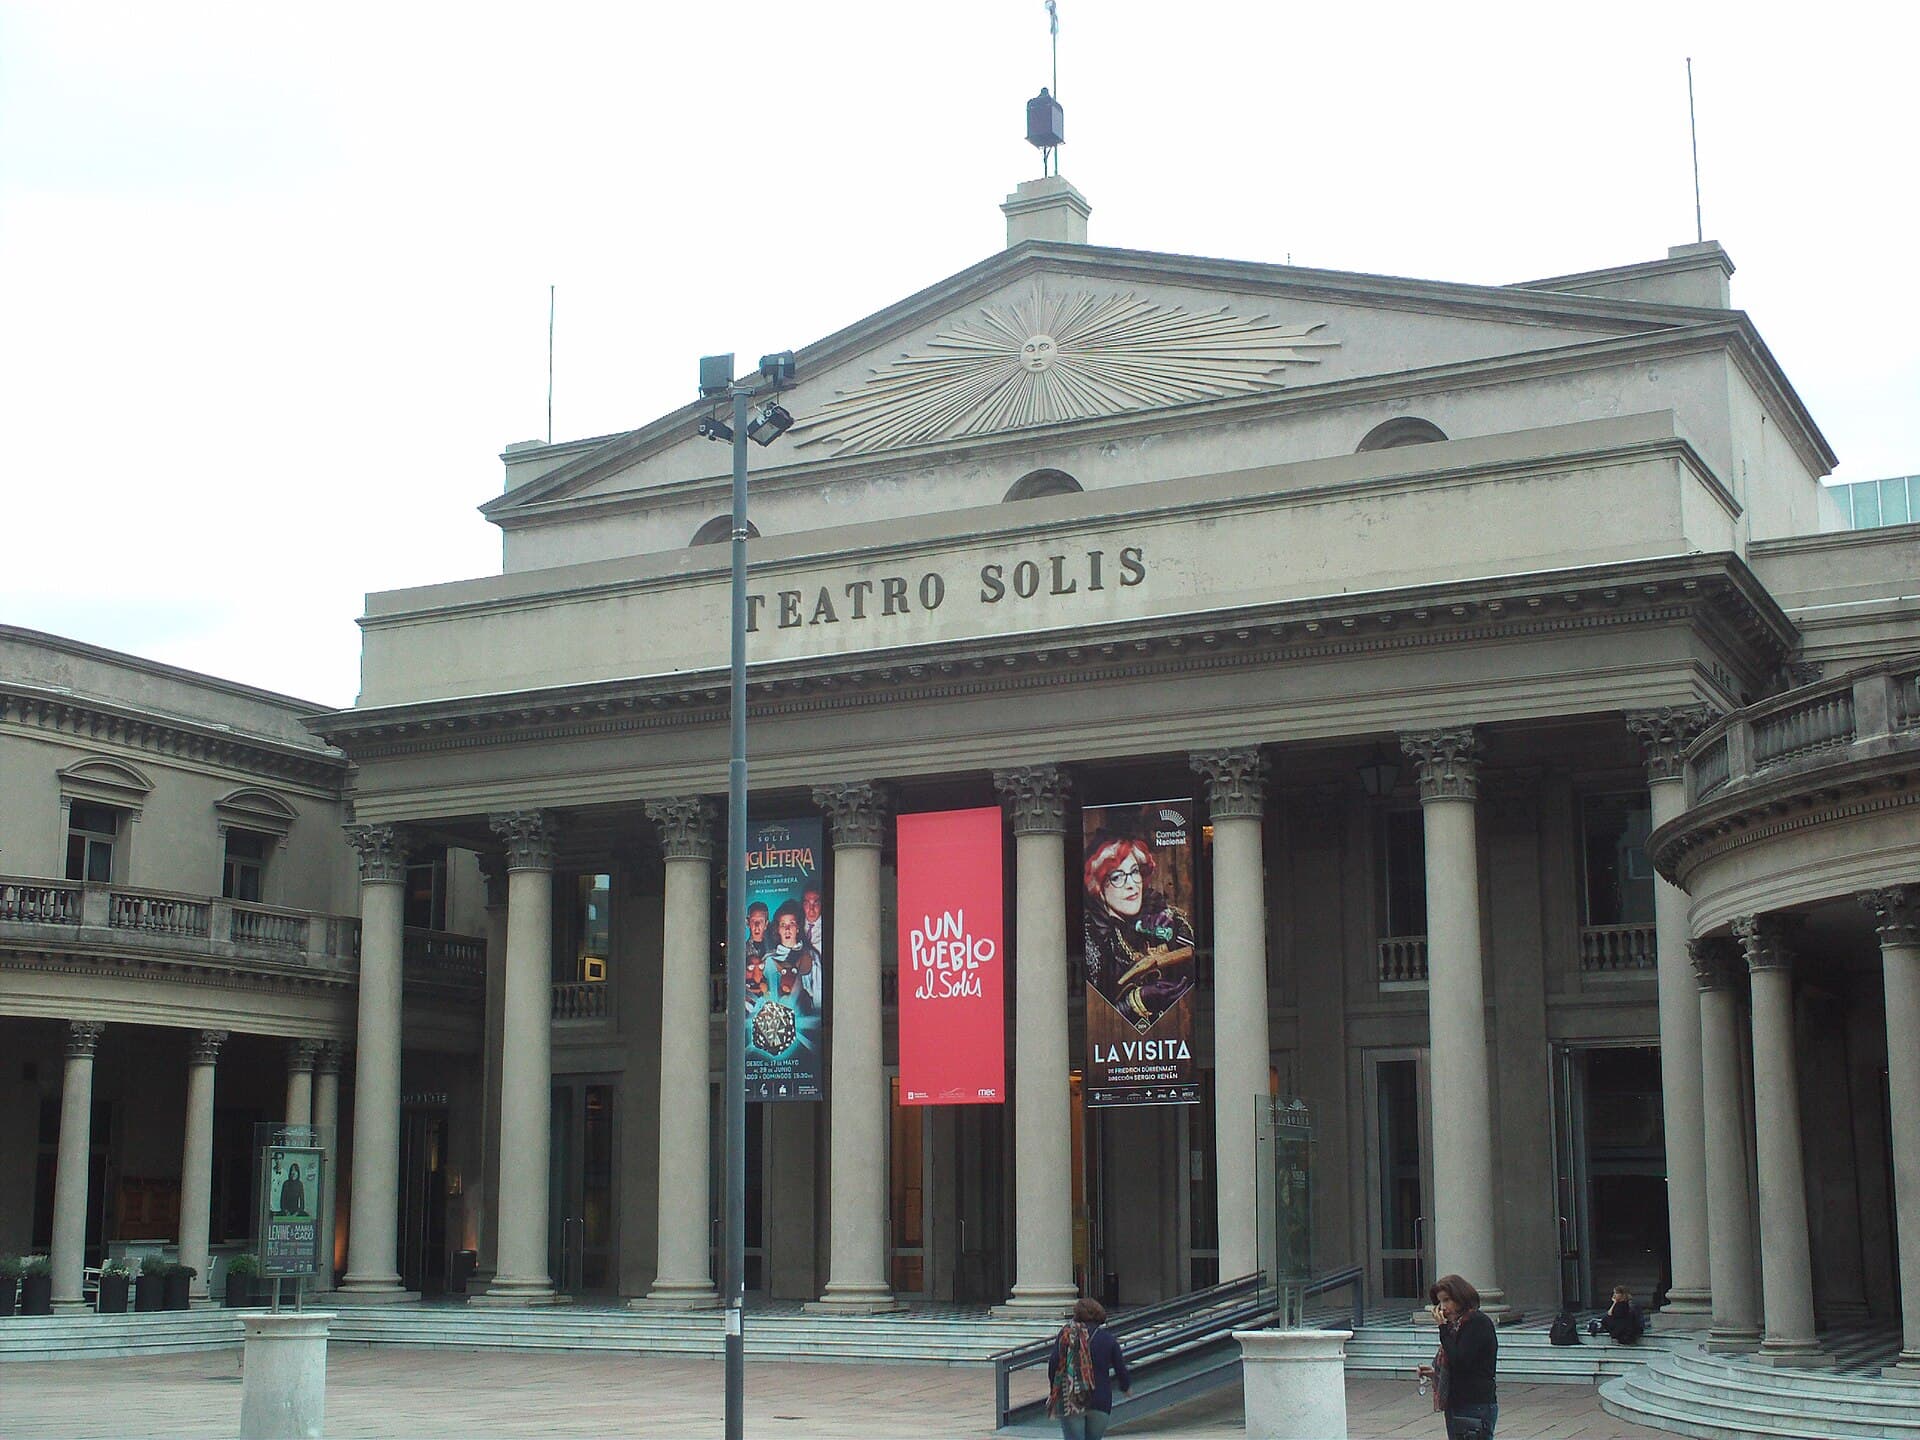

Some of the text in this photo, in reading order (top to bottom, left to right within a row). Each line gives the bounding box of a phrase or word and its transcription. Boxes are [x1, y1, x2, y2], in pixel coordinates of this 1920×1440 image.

[746, 547, 1146, 633] TEATRO SOLIS
[1155, 830, 1186, 838] Comedia
[1156, 838, 1186, 847] Nacional
[924, 909, 963, 942] UN
[910, 930, 995, 972] PUEBLO
[915, 968, 982, 999] al Solís
[1094, 1040, 1191, 1063] LA VISITA
